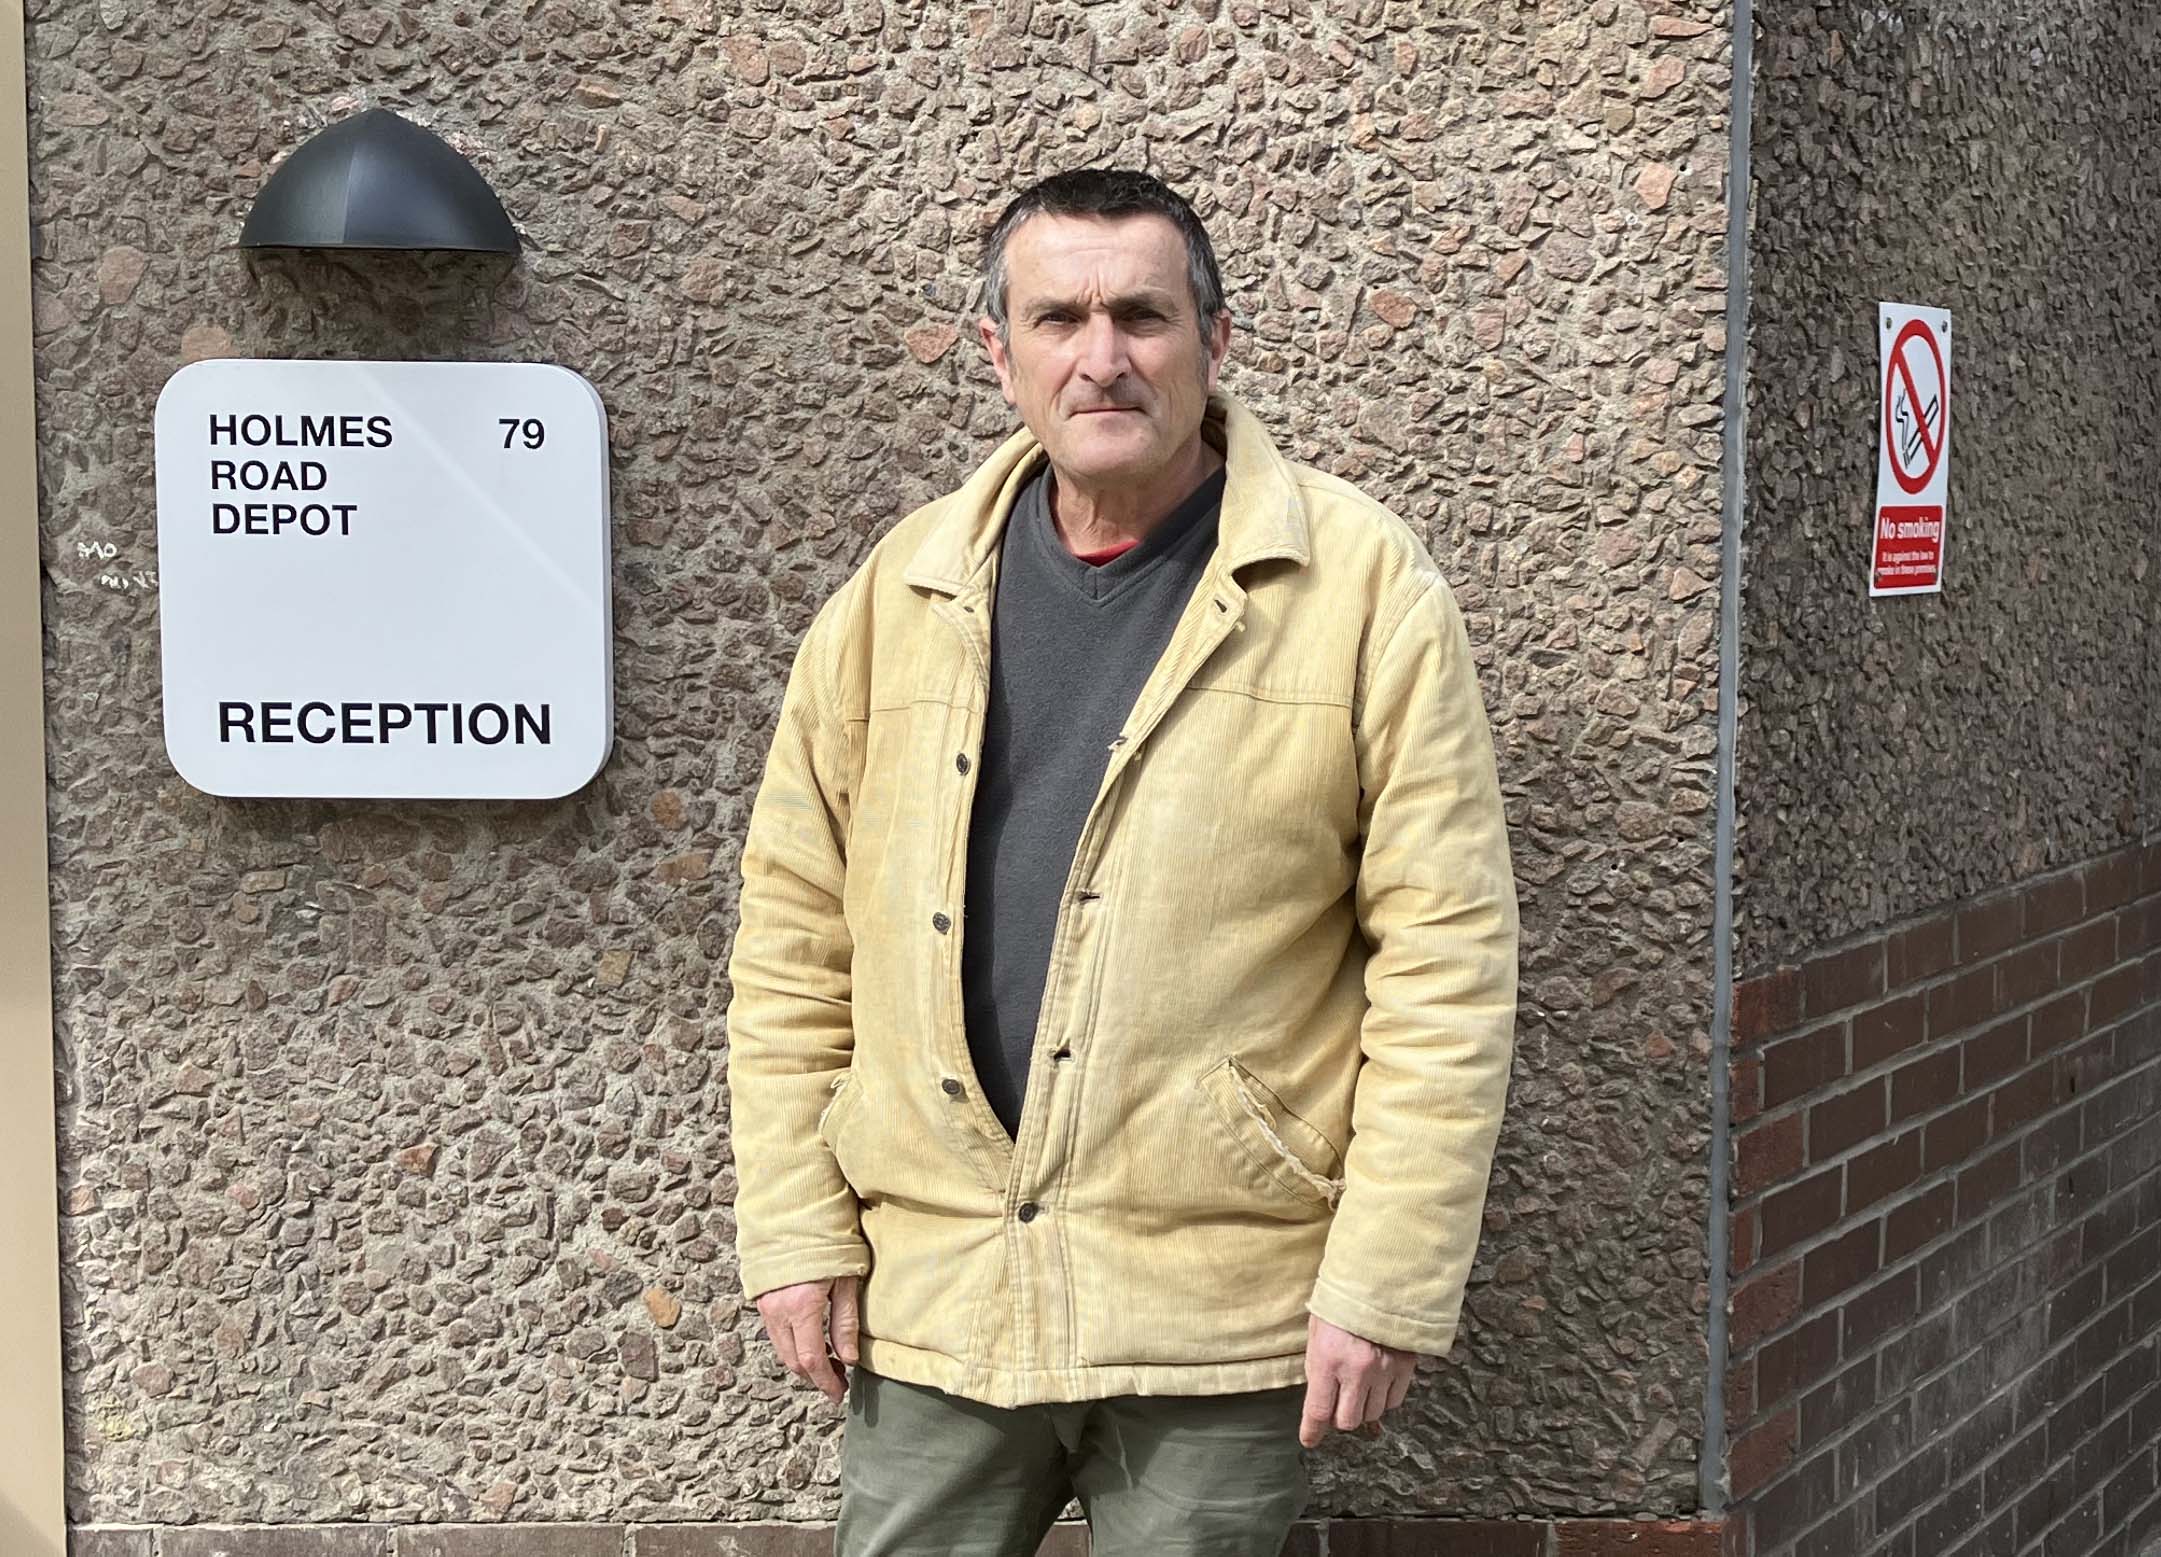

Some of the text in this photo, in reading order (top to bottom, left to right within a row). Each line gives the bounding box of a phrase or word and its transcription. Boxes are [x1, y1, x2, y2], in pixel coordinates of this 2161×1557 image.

[210, 415, 393, 448] HOLMES
[499, 419, 545, 450] 79
[211, 461, 327, 491] ROAD
[213, 504, 358, 536] DEPOT
[1880, 516, 1940, 543] No smoking
[220, 702, 551, 745] RECEPTION
